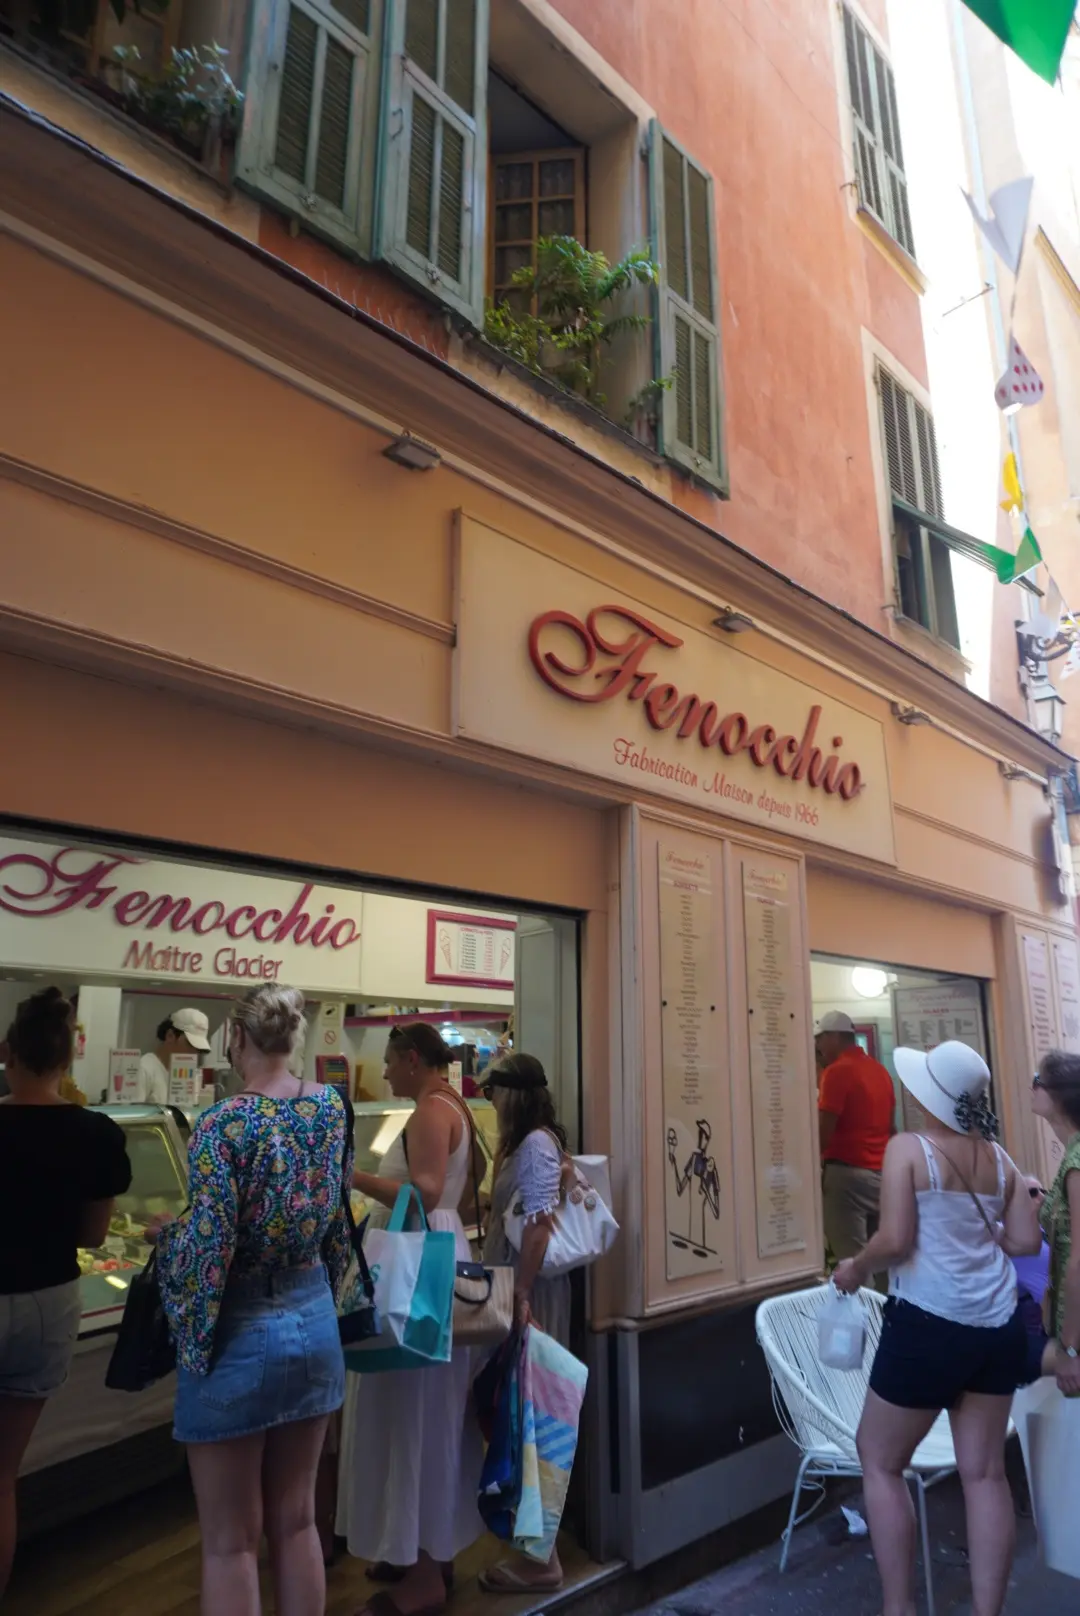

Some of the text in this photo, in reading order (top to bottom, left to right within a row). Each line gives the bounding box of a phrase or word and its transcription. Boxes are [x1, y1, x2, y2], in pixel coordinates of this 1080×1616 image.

[528, 604, 867, 801] Fenocchio
[613, 737, 819, 827] Fabrication Maison depuis 1966
[0, 847, 362, 950] Fenocchio
[213, 946, 284, 980] Glacier
